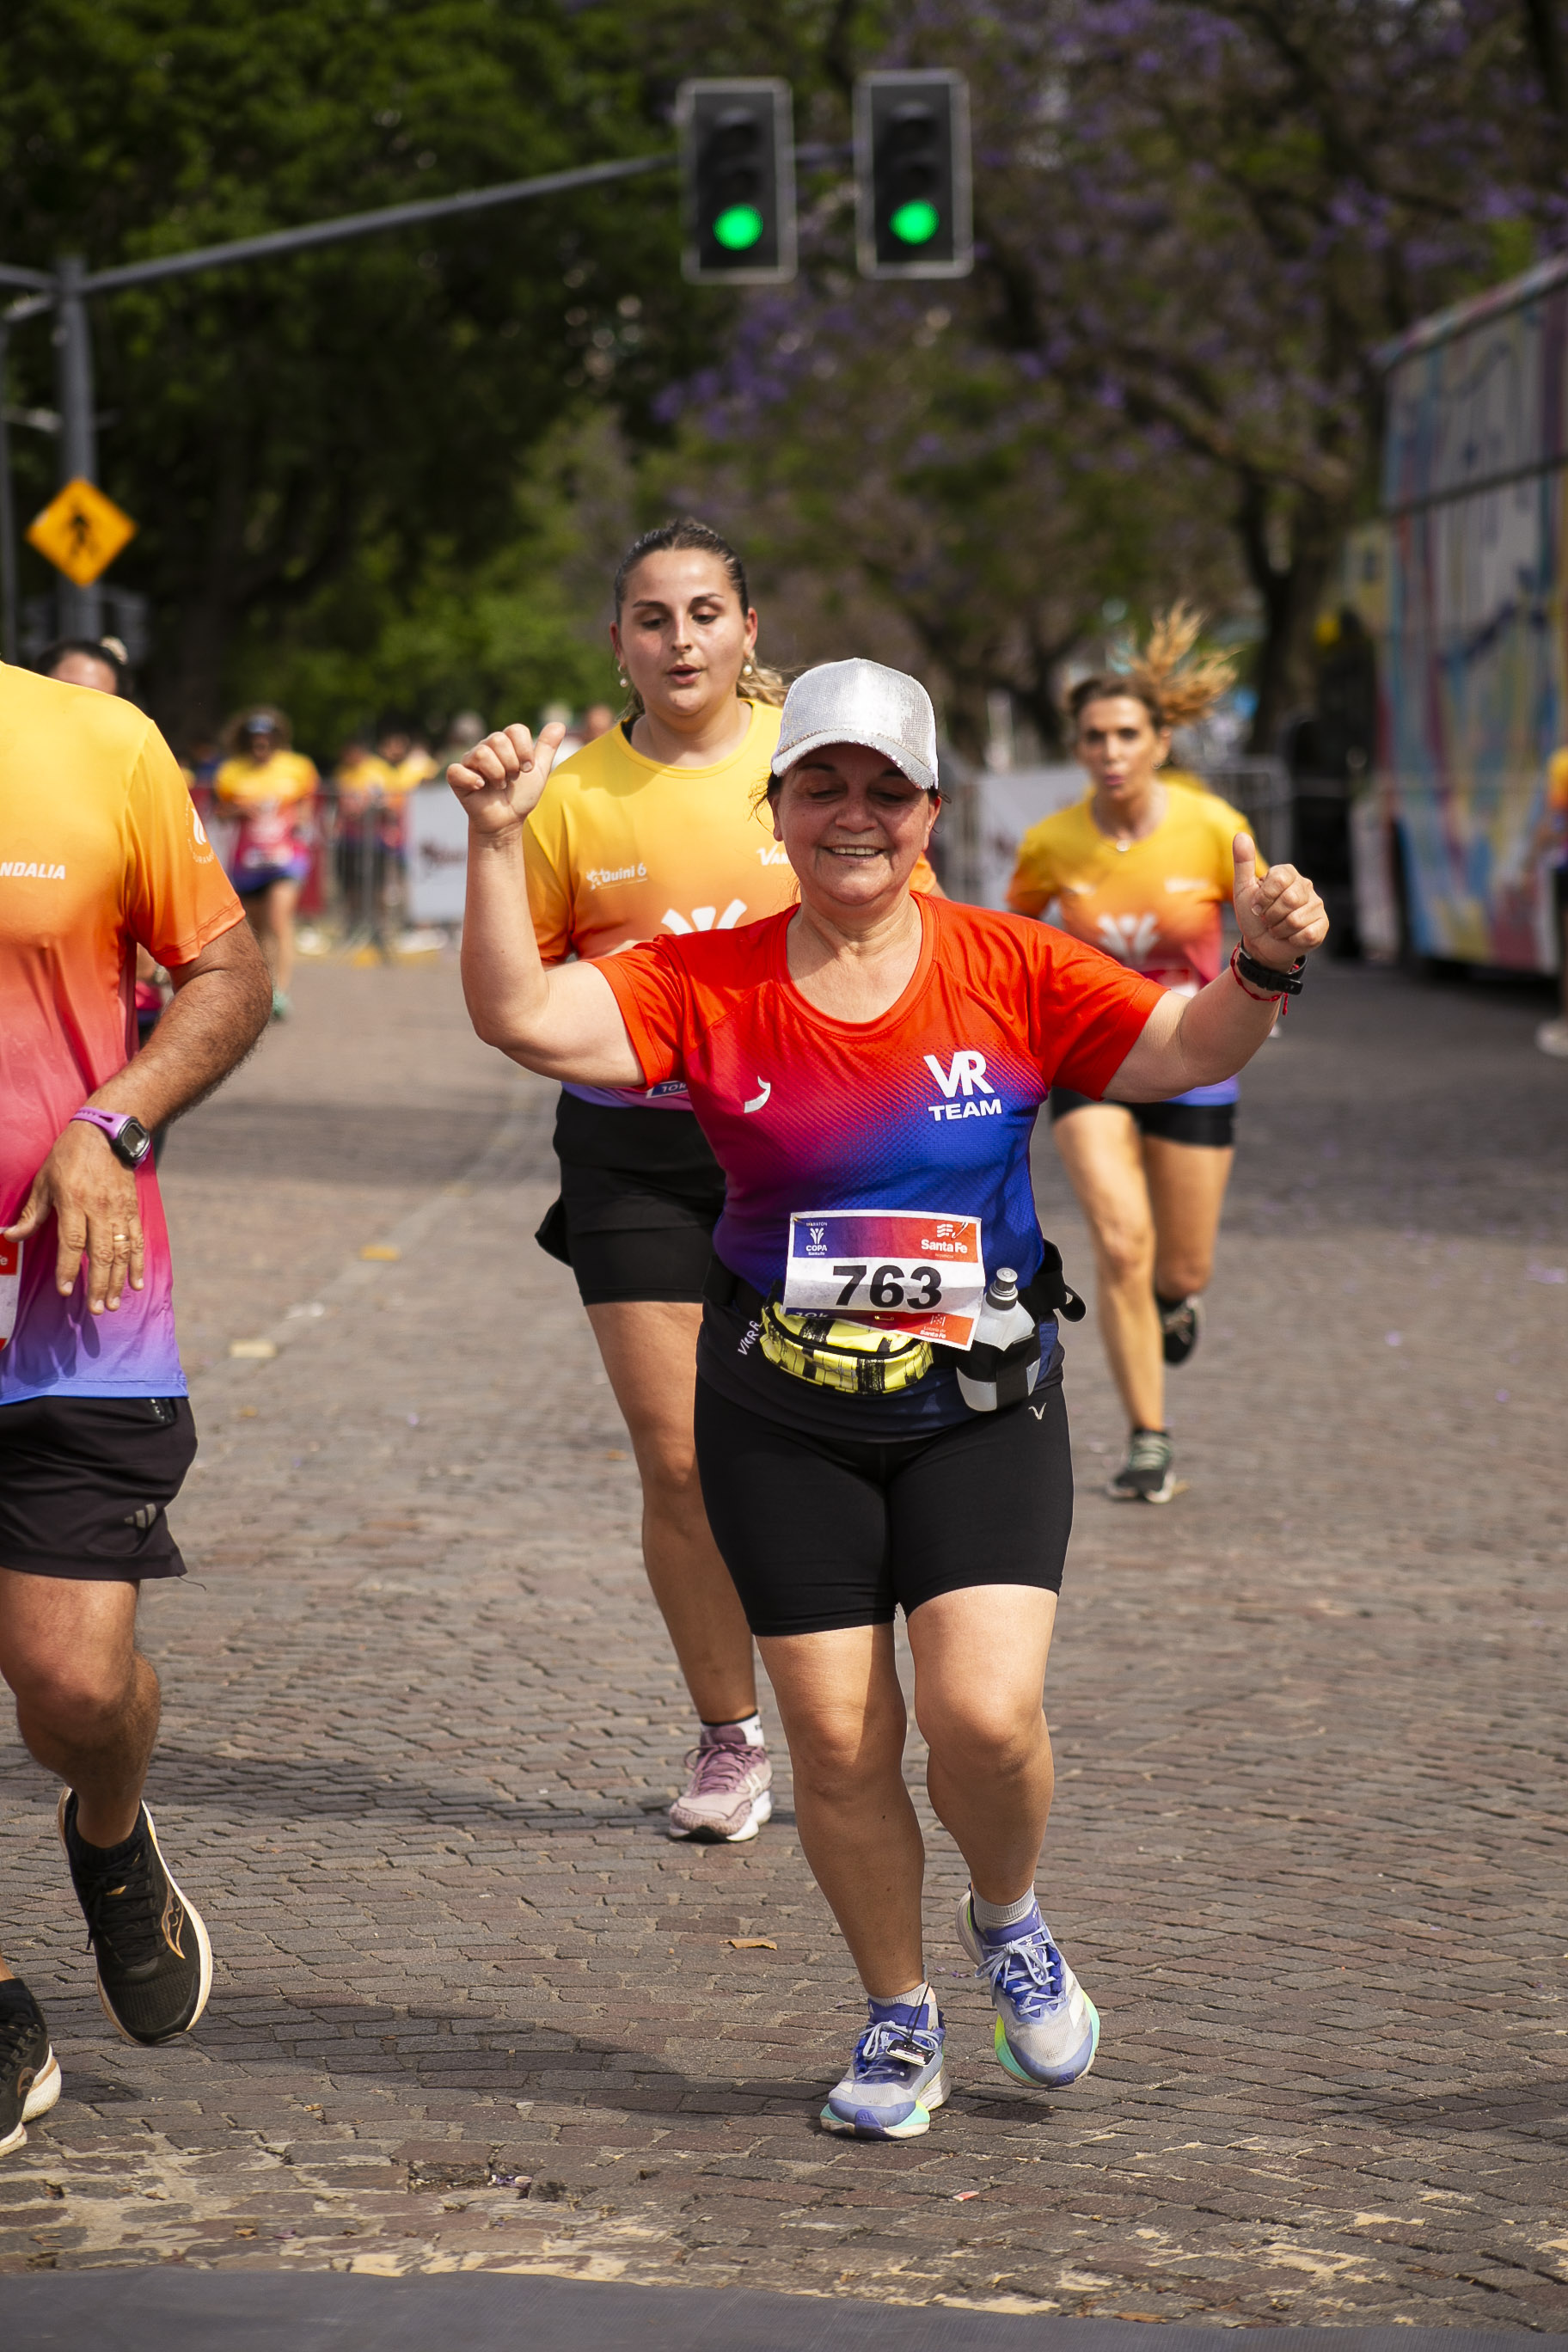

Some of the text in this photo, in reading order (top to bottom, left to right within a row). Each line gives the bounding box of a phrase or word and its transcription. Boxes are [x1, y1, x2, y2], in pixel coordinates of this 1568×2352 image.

[0, 861, 66, 880] NDALIA
[602, 865, 635, 884] Quini
[637, 862, 647, 877] 6
[922, 1050, 995, 1099] VR
[928, 1099, 1002, 1122] TEAM
[921, 1239, 968, 1254] Santa Fe
[0, 1254, 9, 1266] e
[832, 1265, 942, 1310] 763
[920, 1329, 939, 1338] Santa
